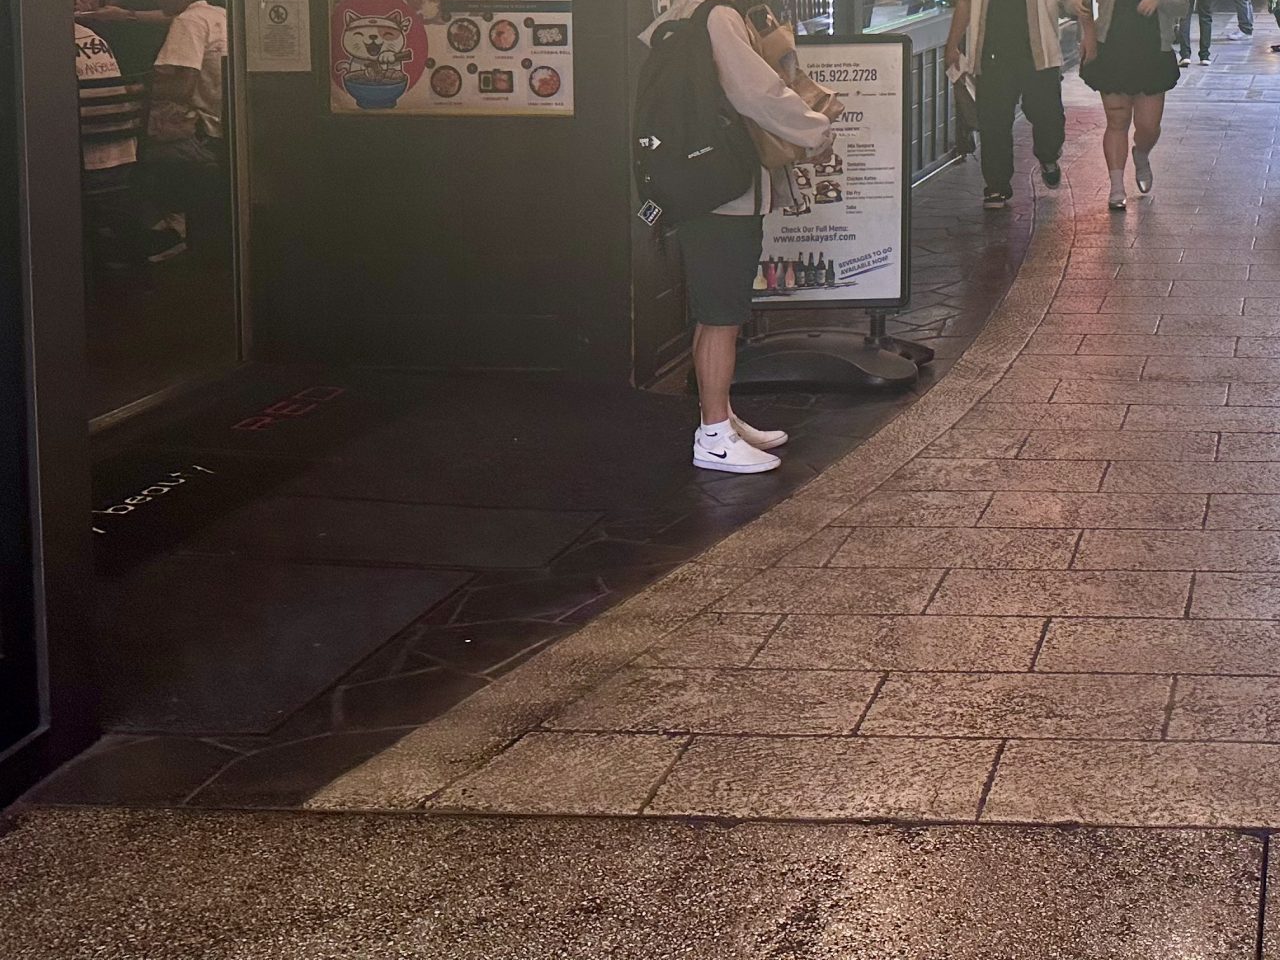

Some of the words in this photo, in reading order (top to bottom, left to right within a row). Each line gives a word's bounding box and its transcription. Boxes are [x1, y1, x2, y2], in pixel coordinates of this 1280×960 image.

[773, 233, 856, 243] www.osakayasf.com
[838, 253, 872, 269] BEVERAGES
[882, 246, 893, 254] GO
[840, 260, 871, 275] AVAILABLE
